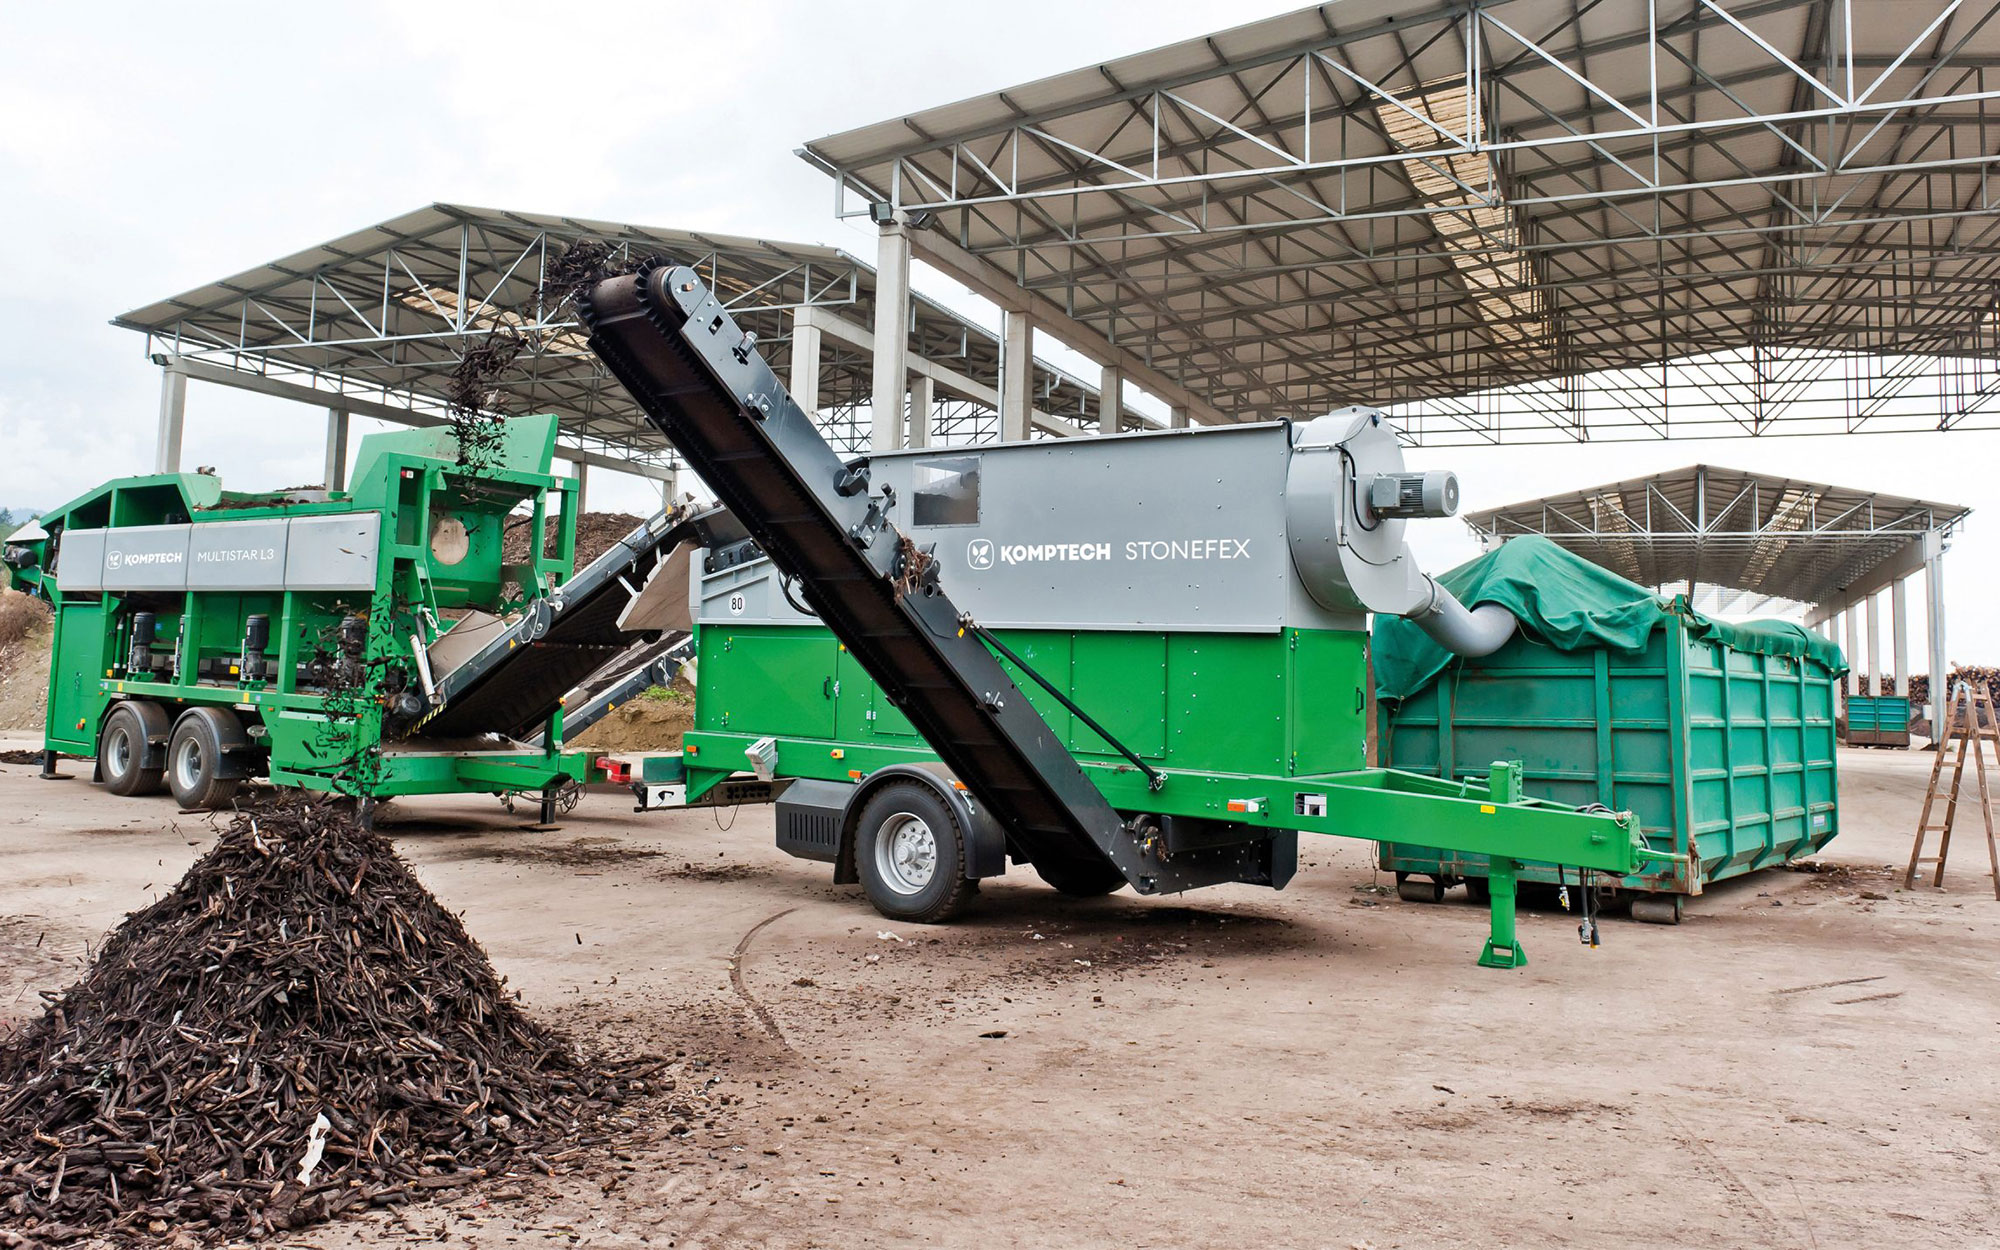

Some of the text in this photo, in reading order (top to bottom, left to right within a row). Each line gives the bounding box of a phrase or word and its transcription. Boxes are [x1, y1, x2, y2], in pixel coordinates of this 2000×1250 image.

[124, 549, 274, 566] KOMPTECH MULTISTAR L3
[1001, 539, 1251, 565] KOMPTECH STONEFEX
[731, 597, 743, 610] 80
